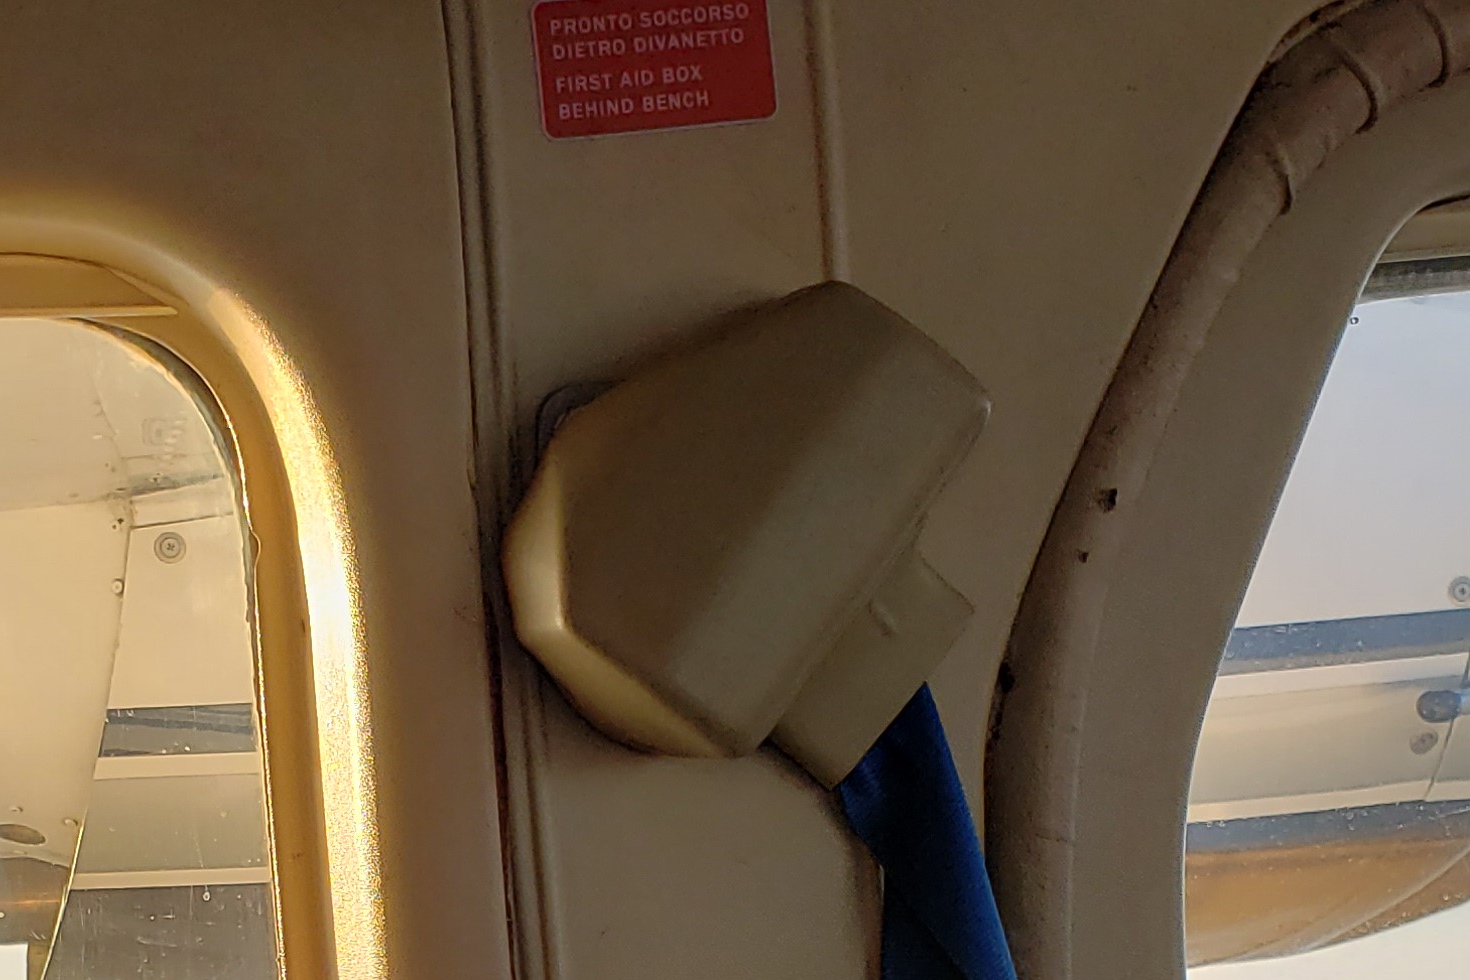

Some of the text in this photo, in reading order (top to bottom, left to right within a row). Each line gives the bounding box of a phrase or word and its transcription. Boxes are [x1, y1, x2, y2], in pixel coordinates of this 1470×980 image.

[550, 3, 749, 36] PRONTO SOCCORSO
[553, 28, 744, 60] DIETRO DIVANETTO
[555, 65, 703, 94] FIRST AID BOX
[559, 90, 710, 120] BEHIND BENCH
